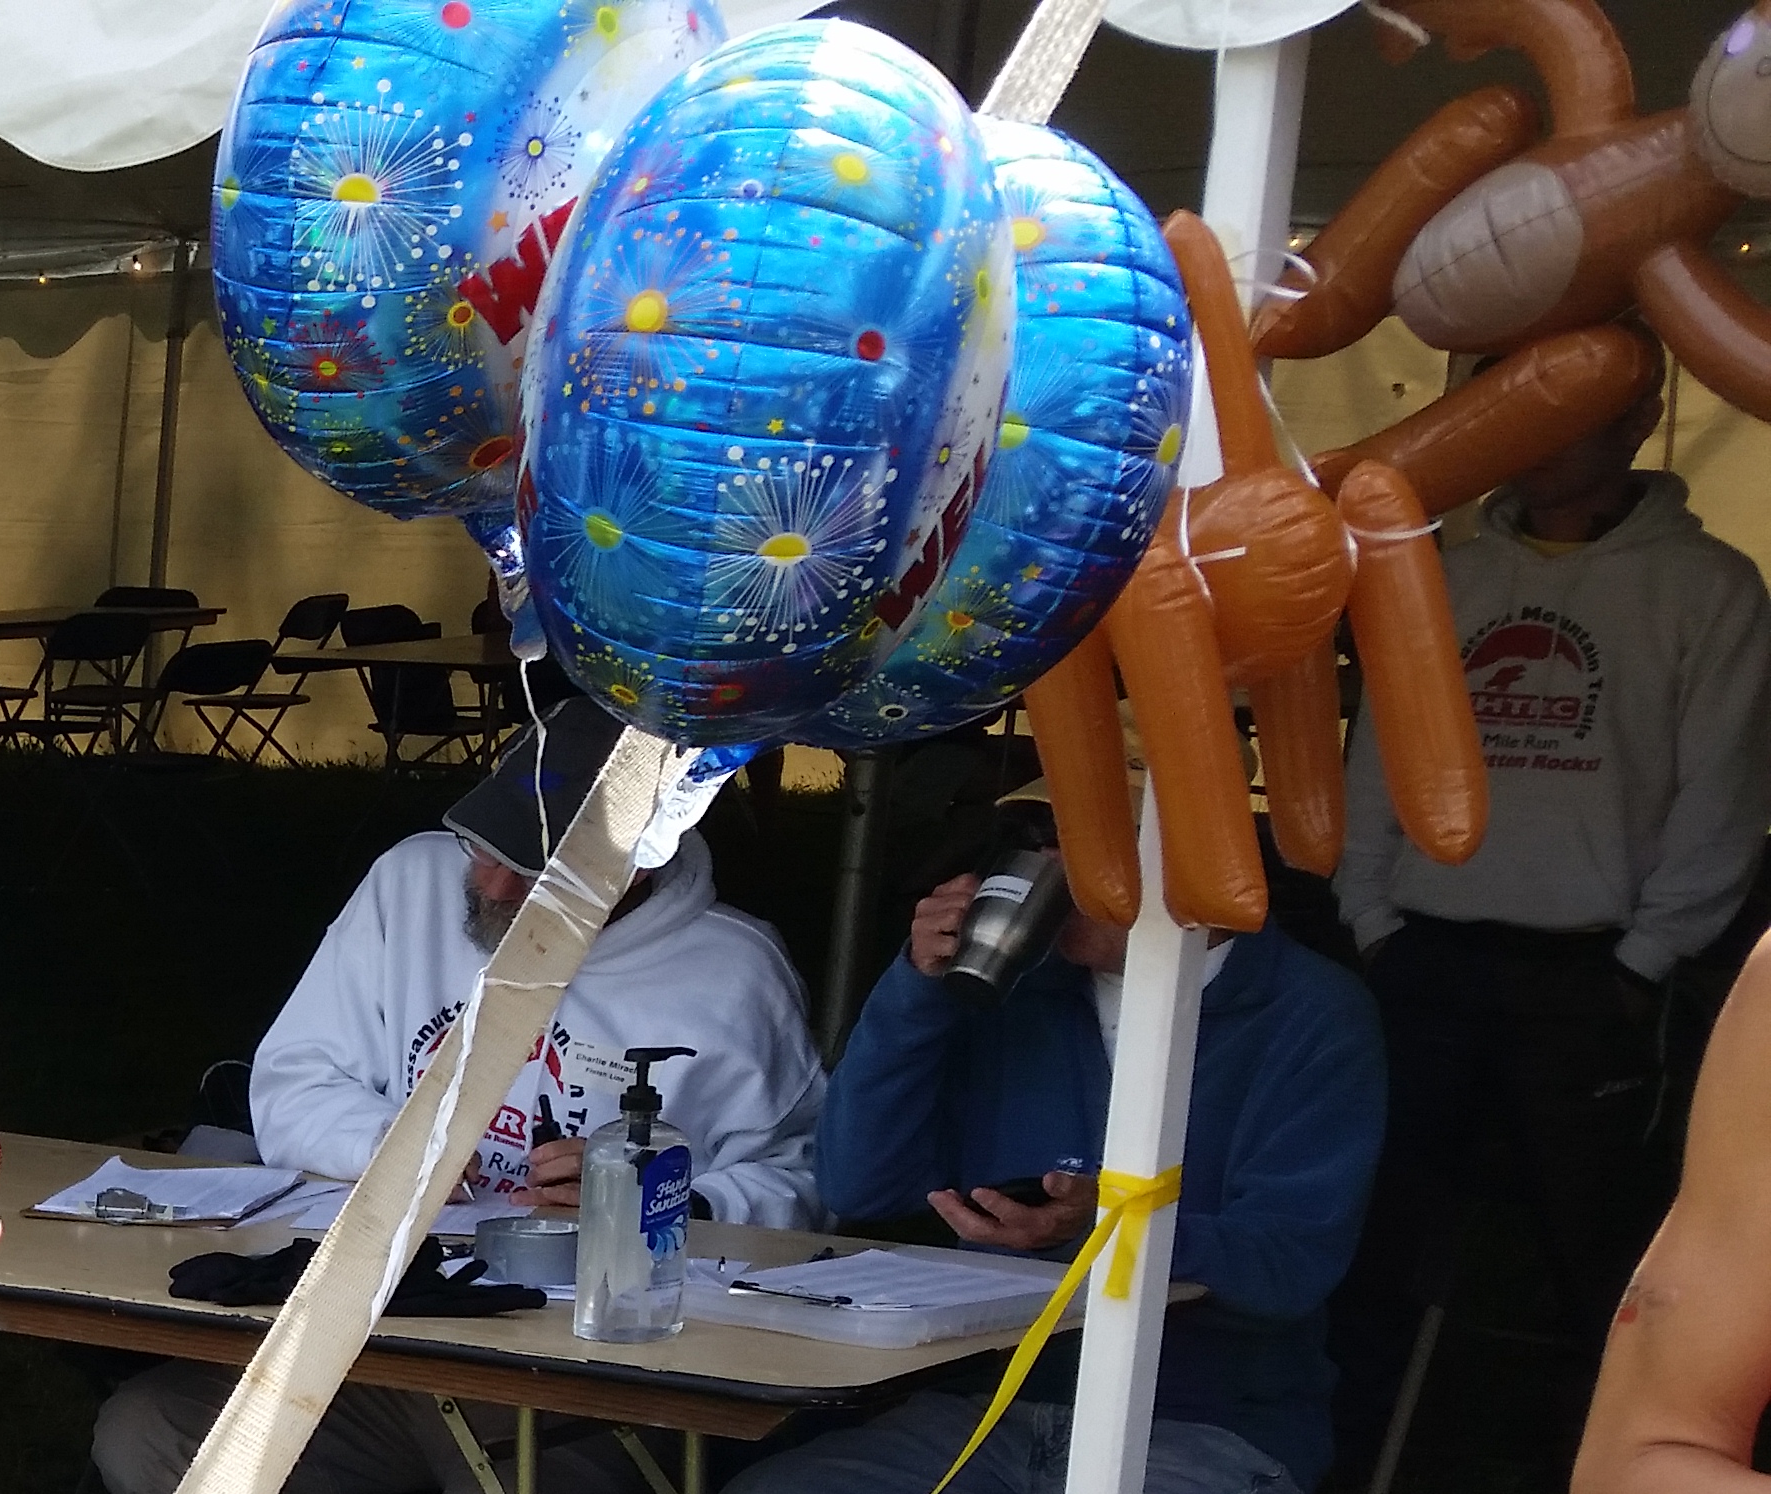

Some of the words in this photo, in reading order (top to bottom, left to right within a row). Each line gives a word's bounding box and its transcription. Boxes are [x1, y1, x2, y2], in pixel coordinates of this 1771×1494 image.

[1482, 733, 1520, 748] Mile
[1524, 733, 1560, 750] Run
[488, 1151, 531, 1178] Run
